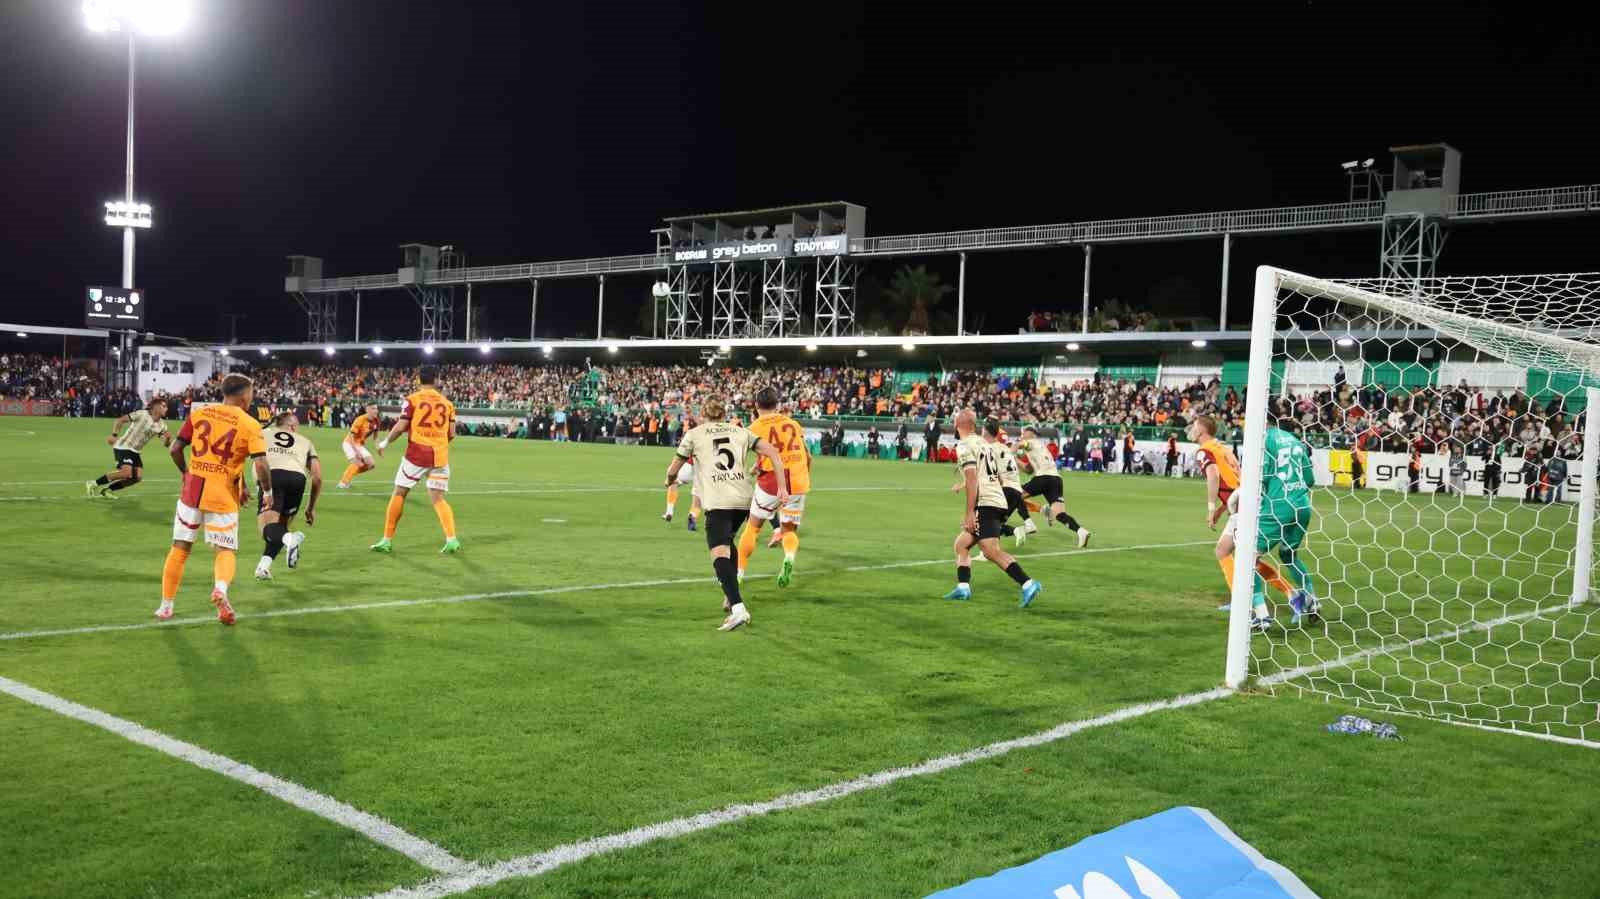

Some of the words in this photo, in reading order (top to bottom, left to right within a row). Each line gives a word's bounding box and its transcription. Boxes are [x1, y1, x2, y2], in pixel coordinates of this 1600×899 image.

[712, 246, 740, 259] grey
[742, 242, 777, 254] beton
[416, 401, 447, 428] 23
[191, 419, 238, 464] 34
[274, 431, 295, 448] 9
[768, 423, 800, 453] 42
[712, 436, 735, 471] 5
[1376, 464, 1443, 485] gry
